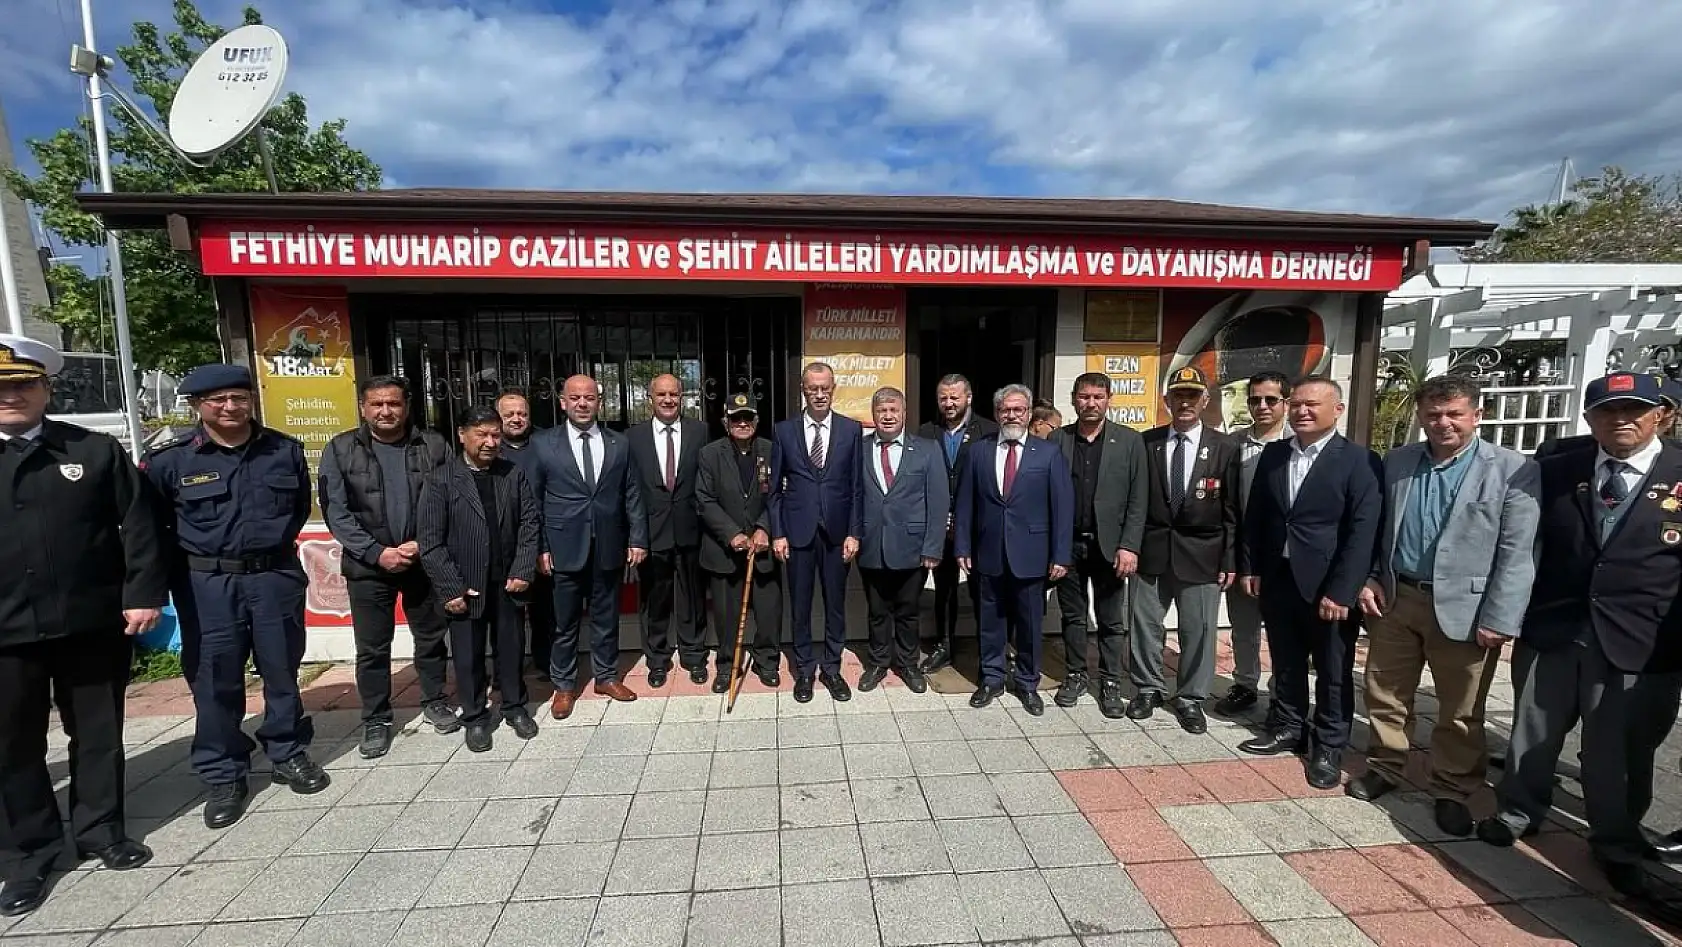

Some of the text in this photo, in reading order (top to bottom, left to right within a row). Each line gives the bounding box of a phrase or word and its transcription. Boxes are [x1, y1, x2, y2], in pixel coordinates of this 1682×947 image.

[242, 72, 256, 82] 32
[229, 225, 1373, 284] FETHİYE MUHARİP GAZİLER ve ŞEHİT AİLELERİ YARDIMLAŞMA ve DAYANIŞMA DERNEĞİ
[815, 305, 898, 324] TÜRK MİLLETİ
[810, 326, 901, 341] KAHRAMANDIR
[273, 356, 332, 376] 18 MART
[849, 354, 897, 371] MİLLETİ
[1105, 356, 1139, 374] EZAN
[1110, 378, 1146, 396] NMEZ
[285, 413, 341, 426] Emanetin
